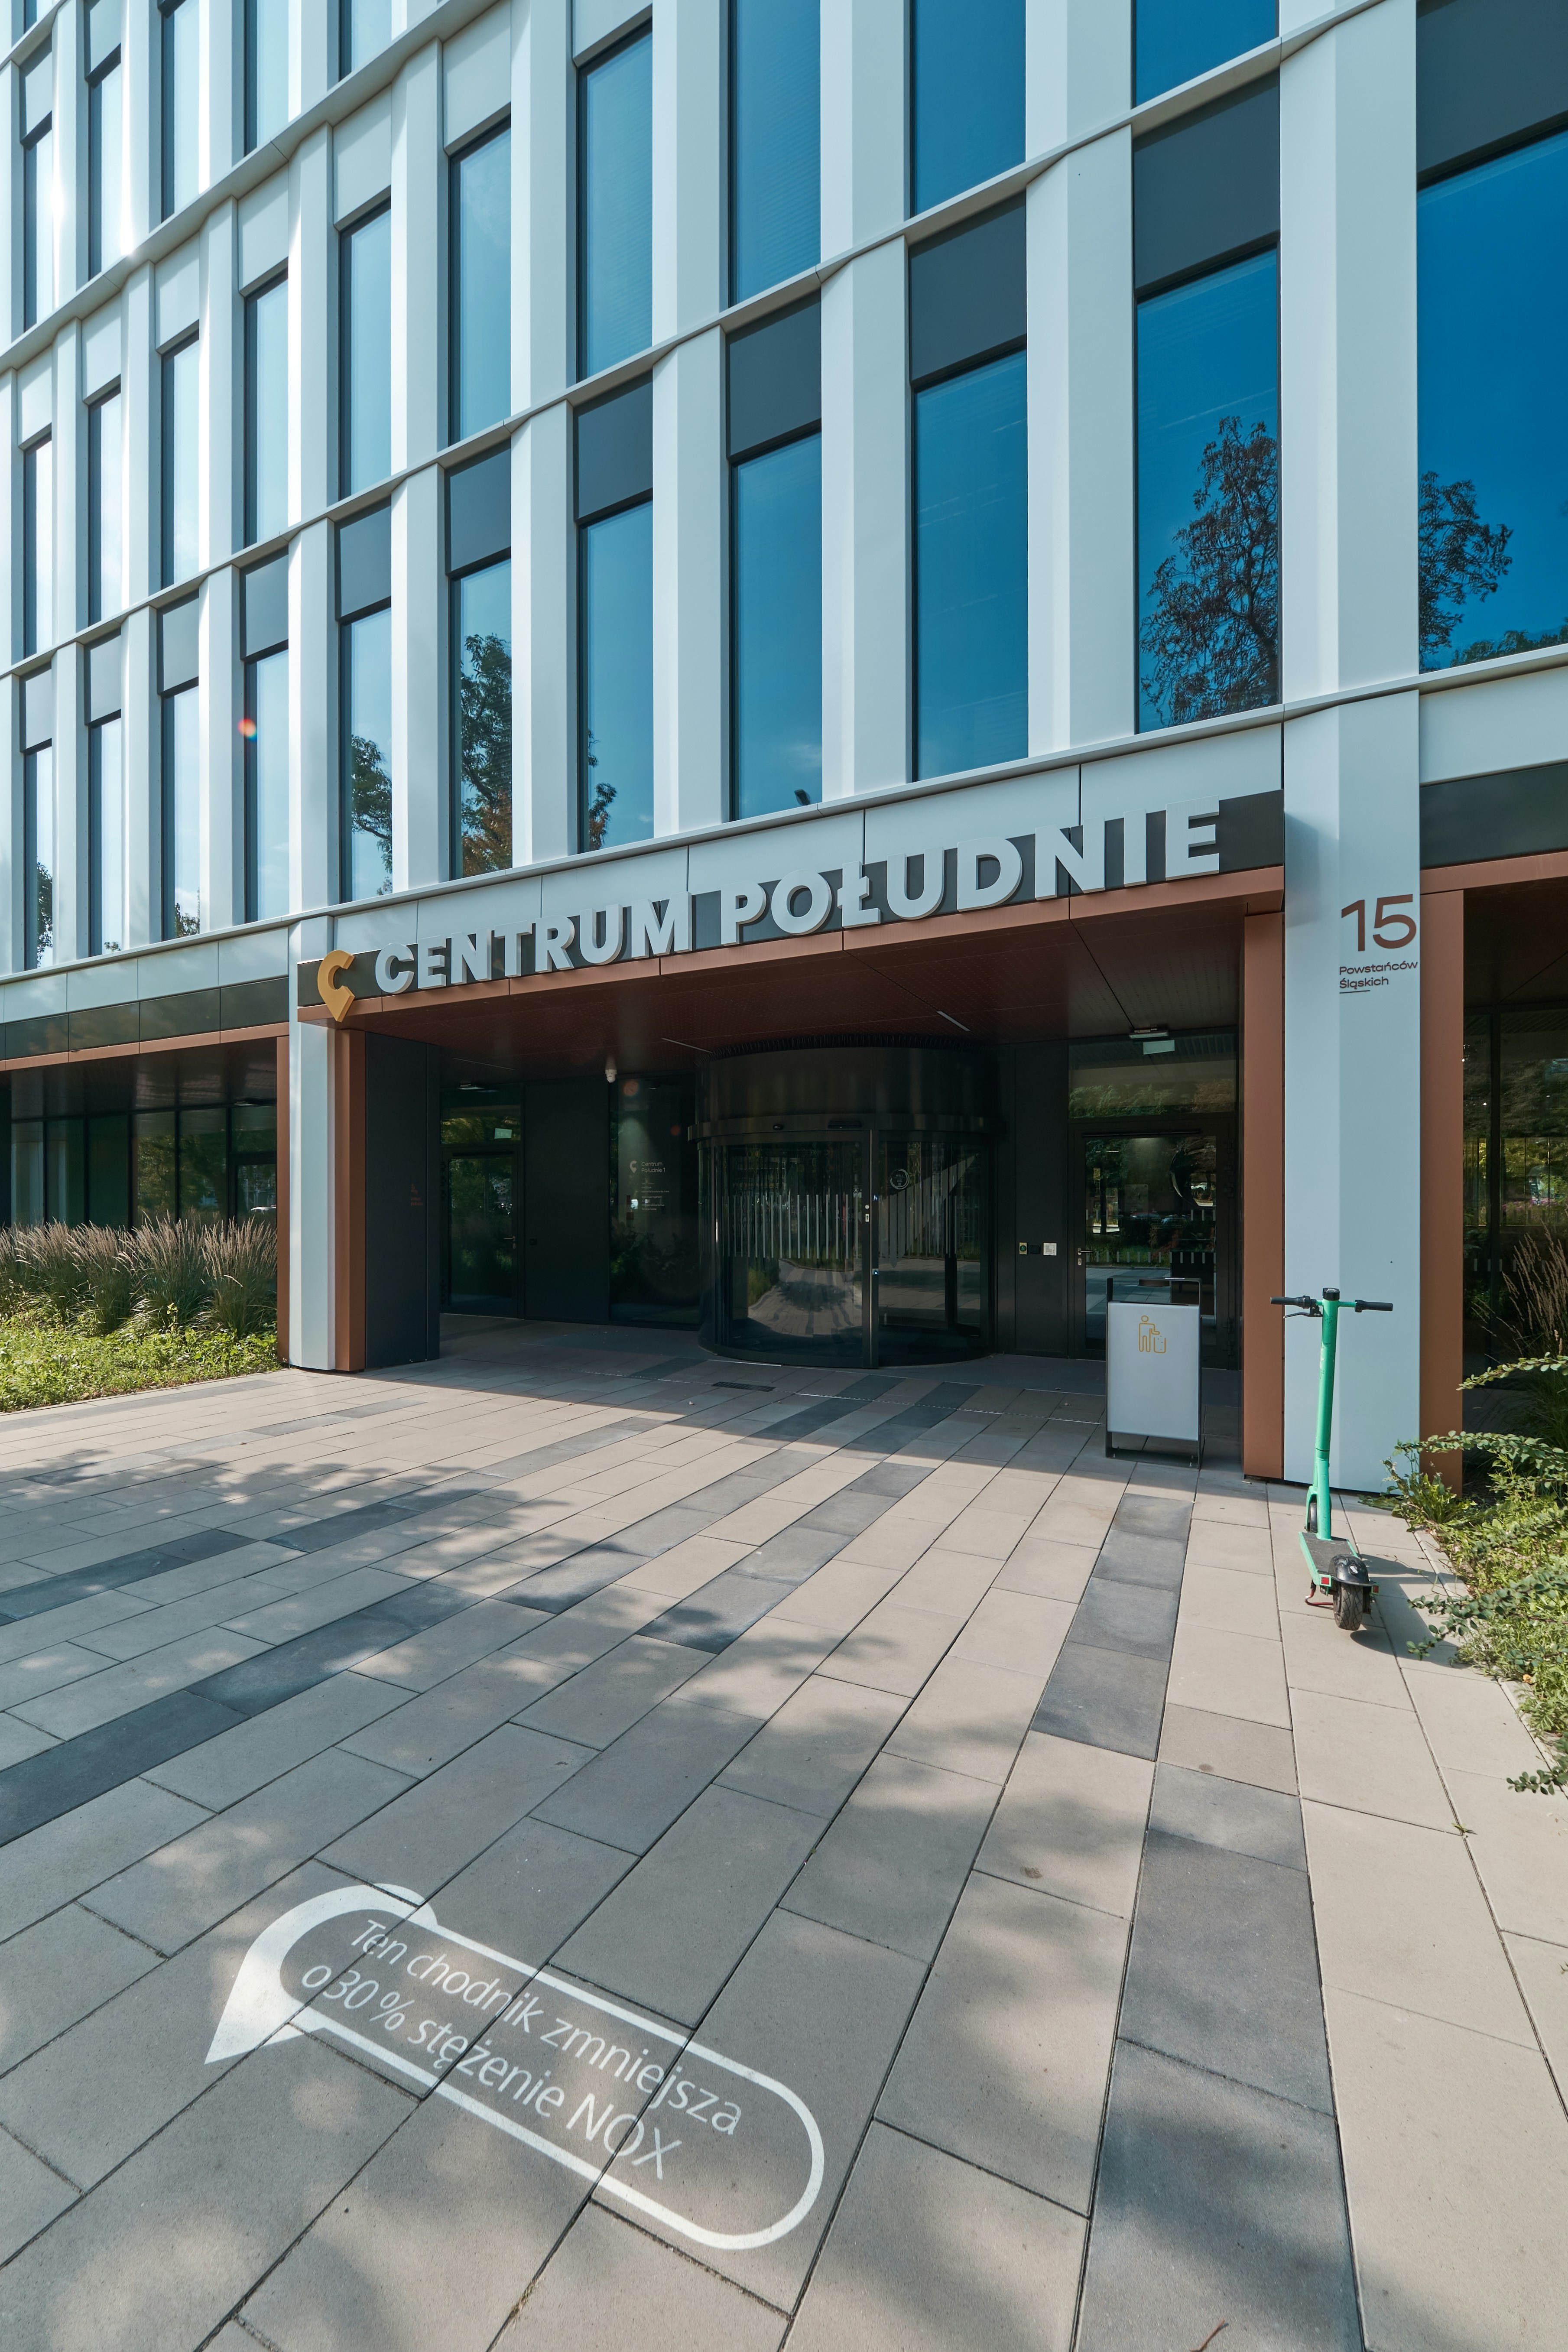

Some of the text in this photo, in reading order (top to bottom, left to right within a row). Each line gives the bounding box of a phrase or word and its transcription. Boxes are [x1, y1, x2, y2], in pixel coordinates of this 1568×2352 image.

[375, 795, 1220, 994] CENTRUM POŁUDNIE
[1341, 894, 1417, 952] 15
[1339, 960, 1418, 975] Powstańców
[1339, 976, 1389, 990] Śląskich
[351, 1920, 742, 2135] Ten chodnik zmniejsza
[407, 2020, 565, 2117] stężenie
[566, 2093, 683, 2180] NOX
